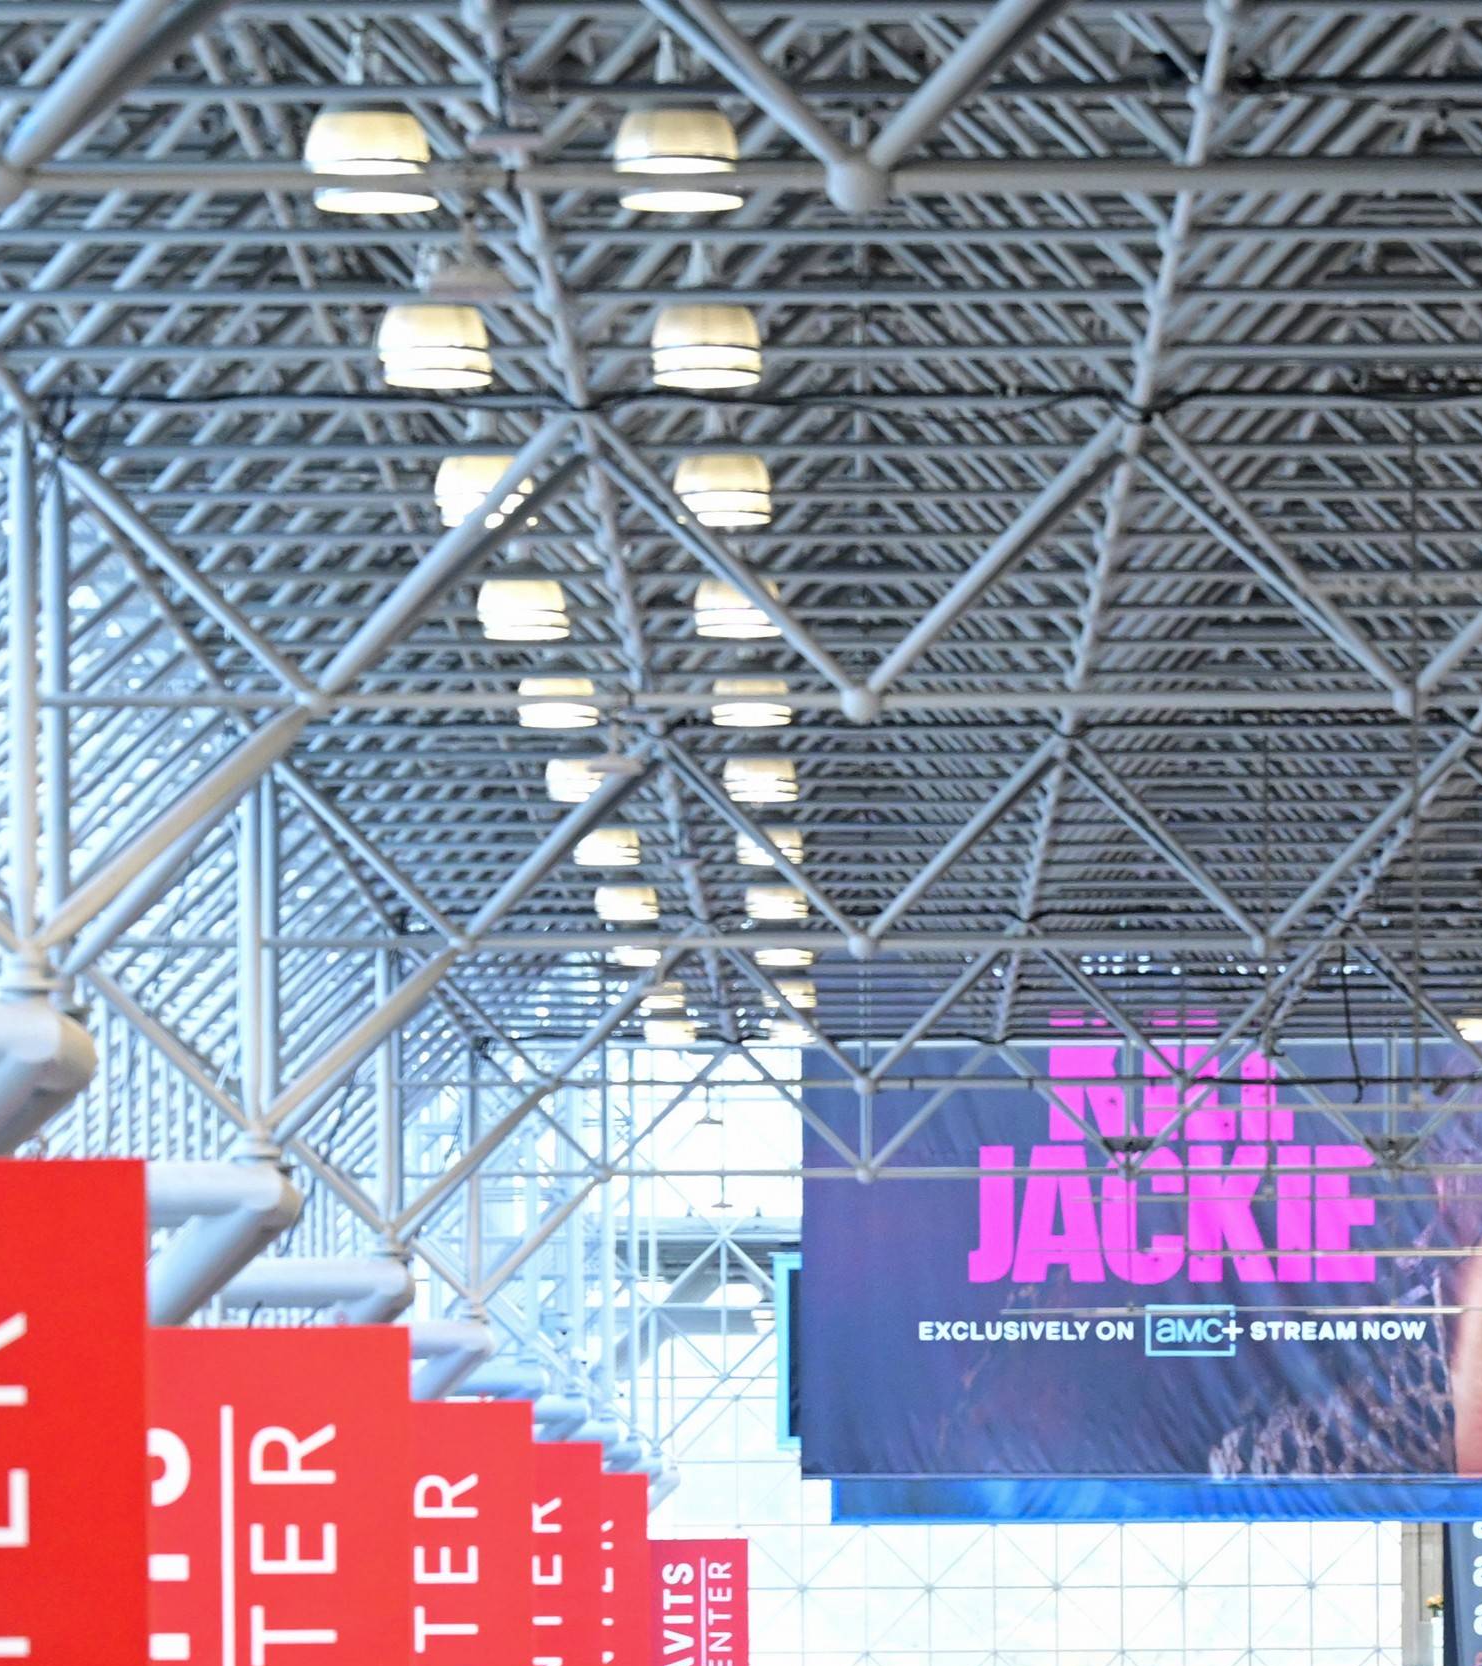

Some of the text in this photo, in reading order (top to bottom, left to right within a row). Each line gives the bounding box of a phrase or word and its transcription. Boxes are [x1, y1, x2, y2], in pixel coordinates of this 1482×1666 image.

[968, 1144, 1376, 1285] JACKIE
[918, 1319, 1090, 1342] EXCLUSIVELY
[1095, 1319, 1135, 1342] ON
[1249, 1319, 1359, 1342] STREAM
[1361, 1319, 1427, 1342] NOW
